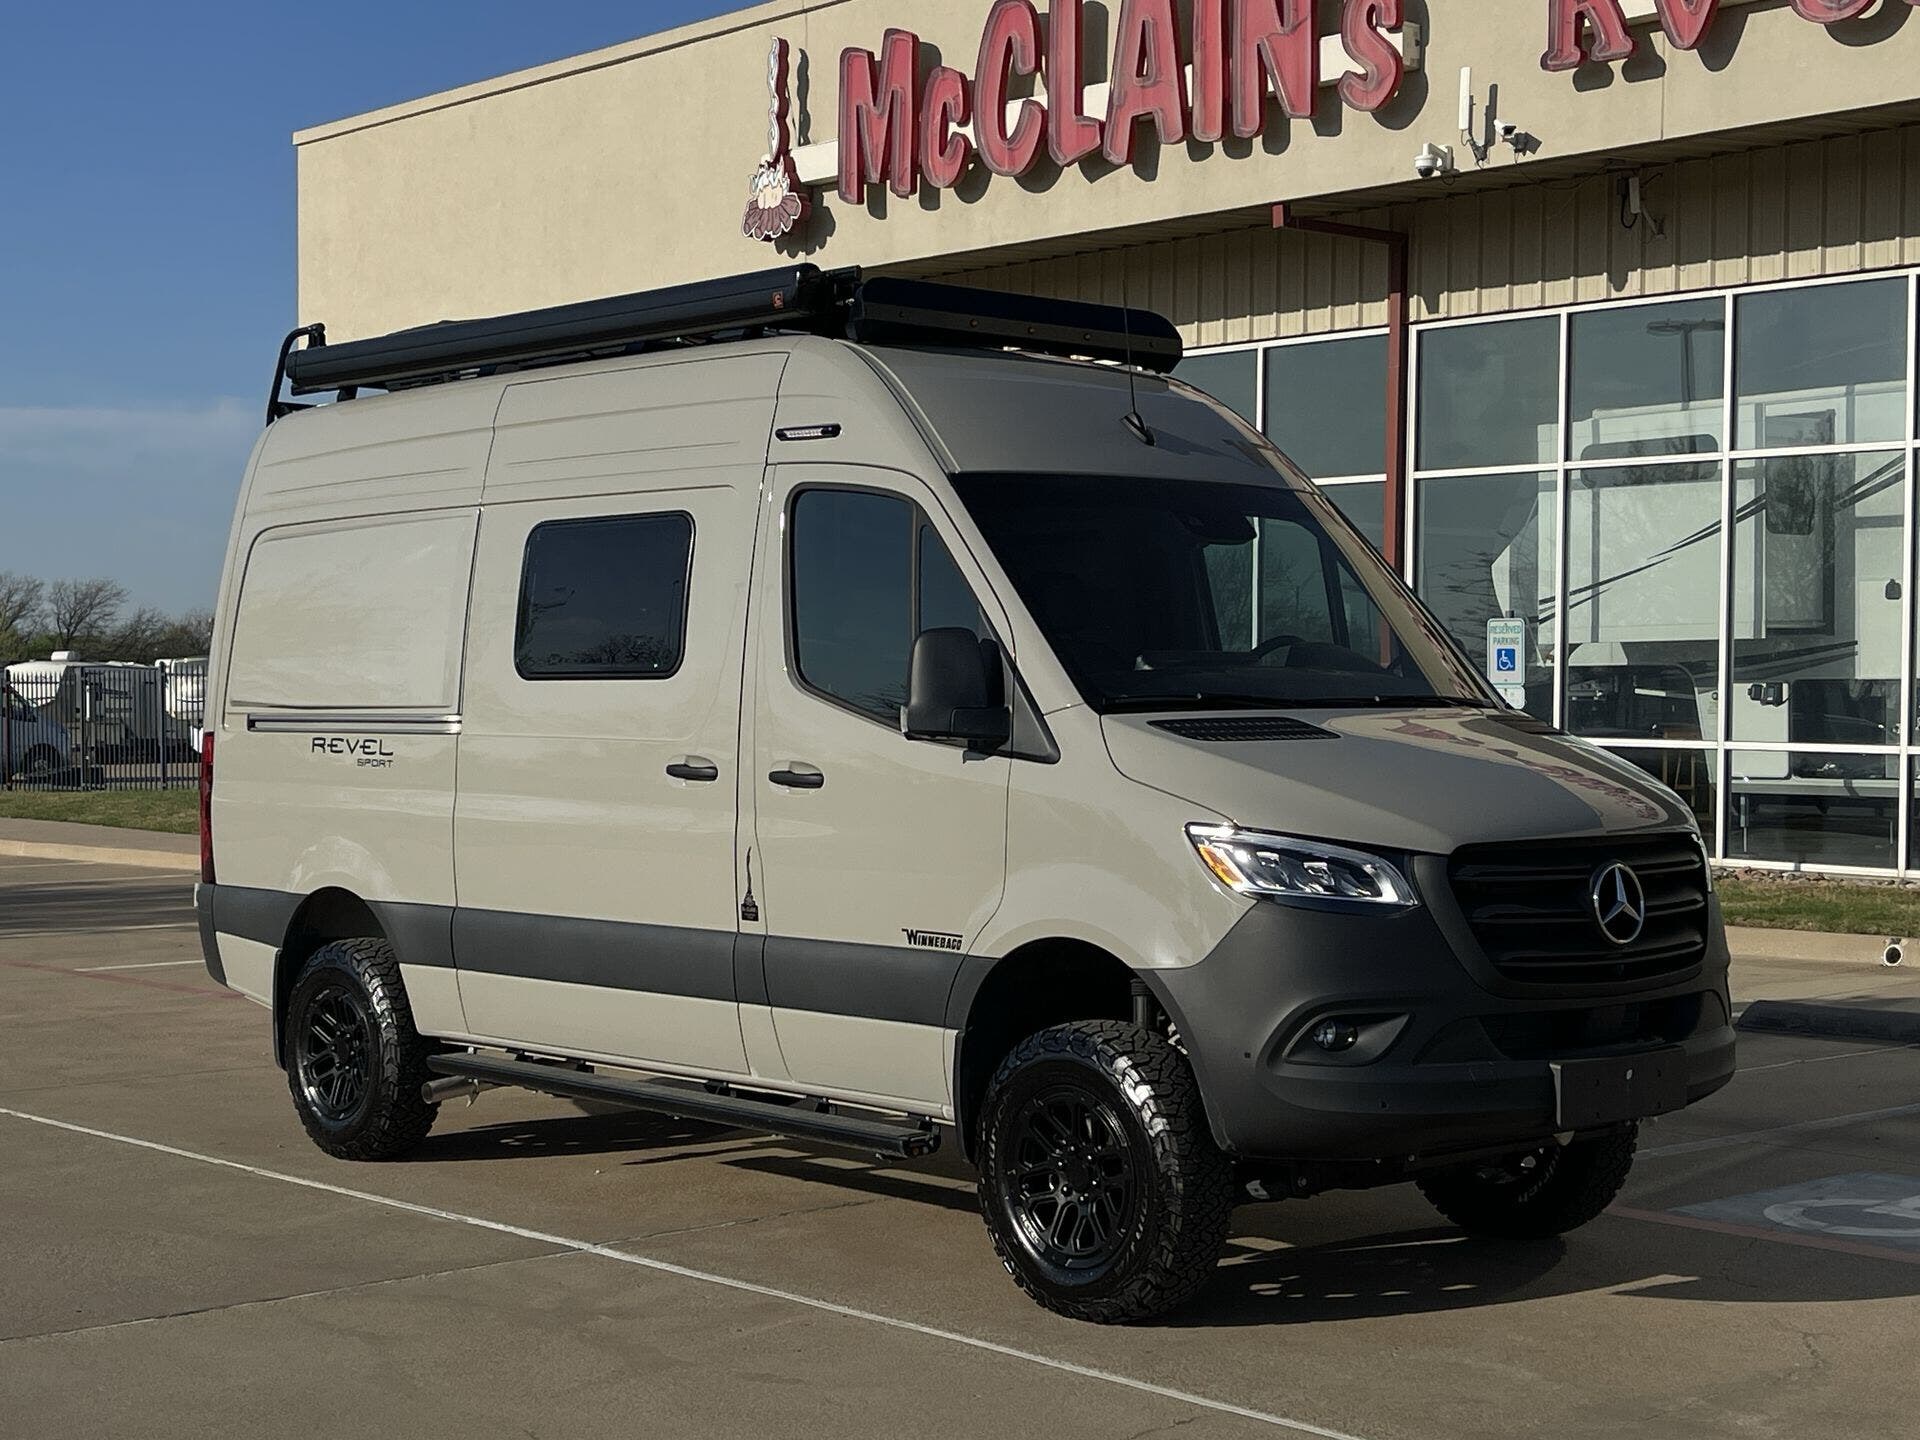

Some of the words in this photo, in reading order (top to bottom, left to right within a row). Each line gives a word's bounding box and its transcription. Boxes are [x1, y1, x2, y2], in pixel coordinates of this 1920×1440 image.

[1489, 625, 1521, 634] RESERVED
[1493, 637, 1519, 645] PARKING
[311, 737, 394, 756] REVEL
[357, 758, 394, 768] SPORT
